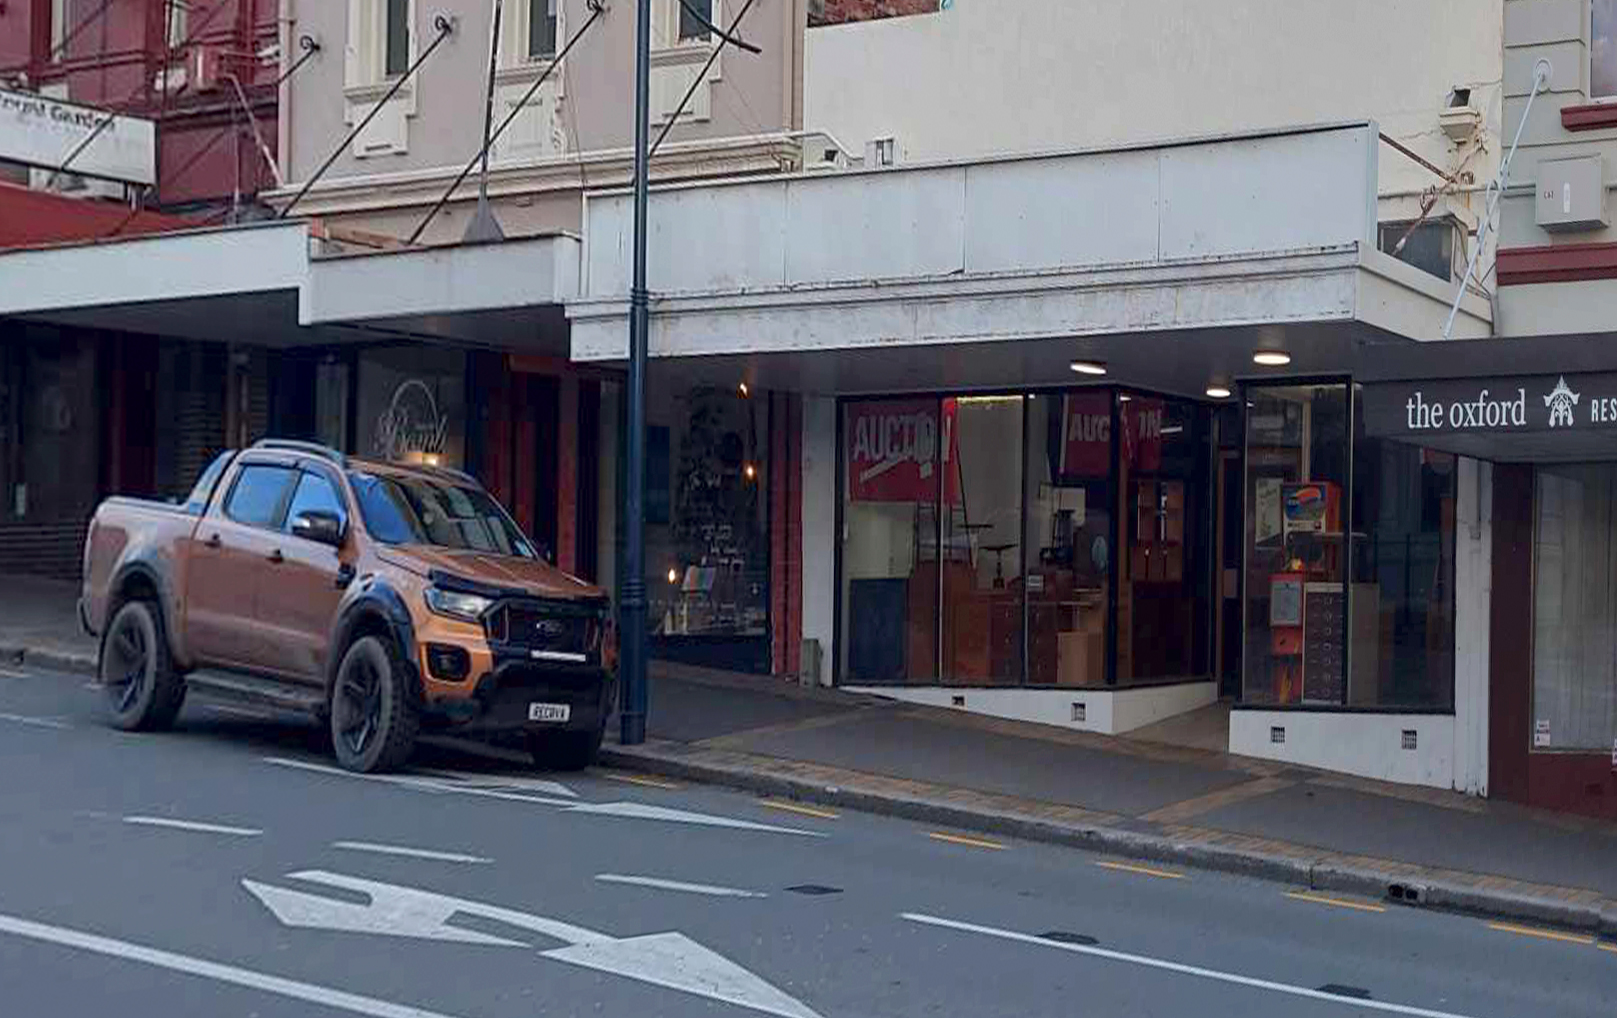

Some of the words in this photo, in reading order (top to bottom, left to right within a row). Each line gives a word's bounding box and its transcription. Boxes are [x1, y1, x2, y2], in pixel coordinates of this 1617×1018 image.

[1405, 392, 1444, 429] the
[1449, 388, 1527, 428] oxford
[853, 412, 953, 466] AUCTION
